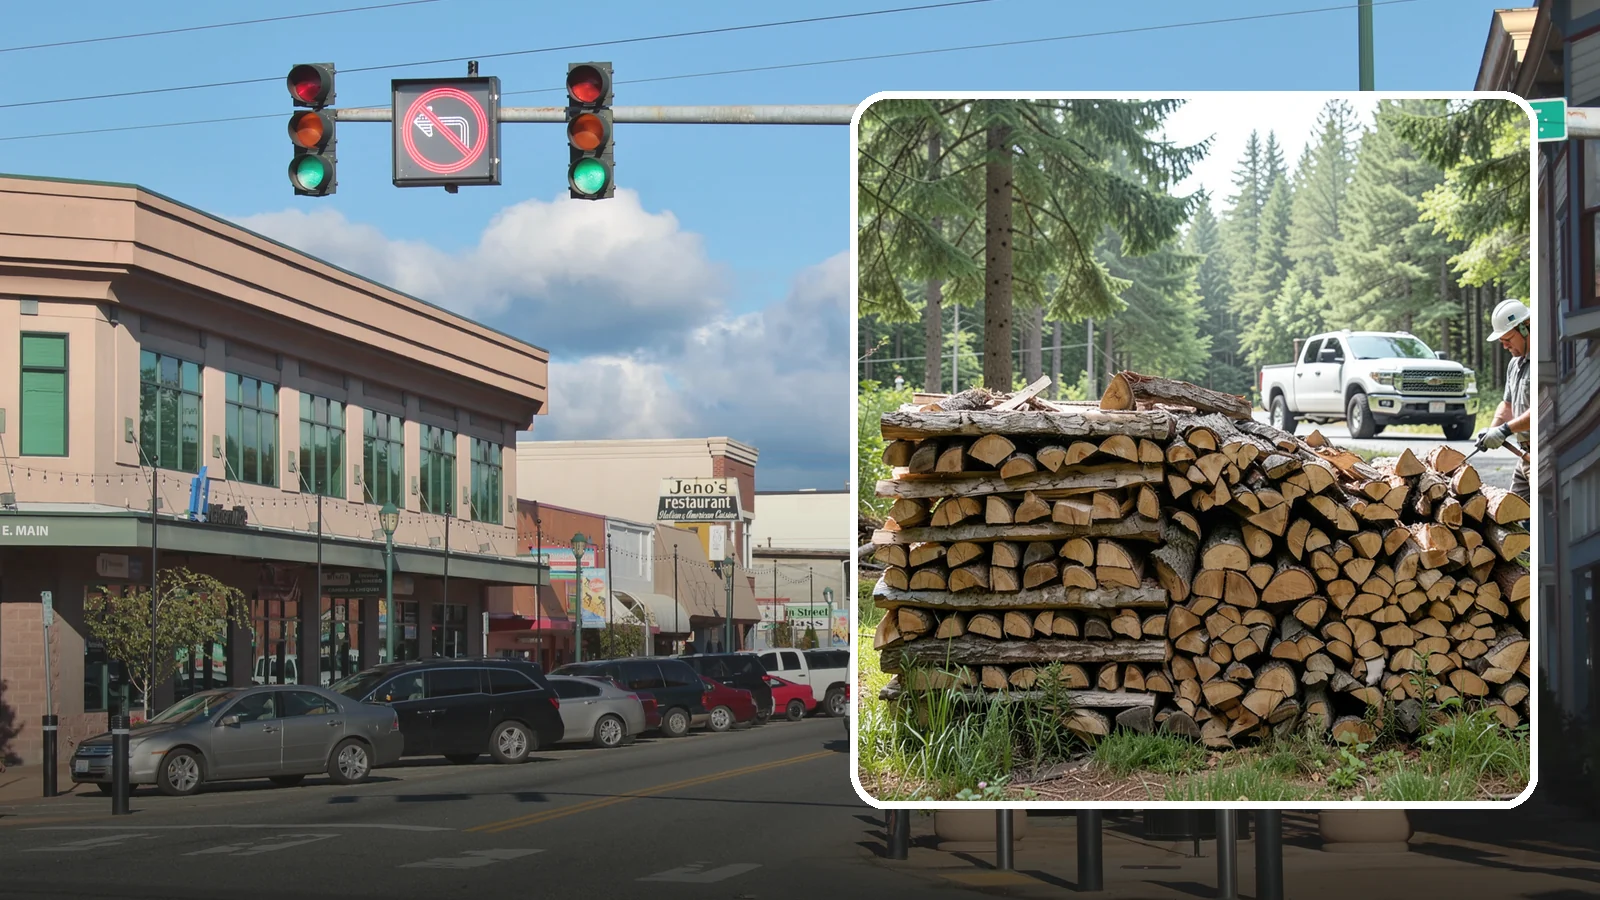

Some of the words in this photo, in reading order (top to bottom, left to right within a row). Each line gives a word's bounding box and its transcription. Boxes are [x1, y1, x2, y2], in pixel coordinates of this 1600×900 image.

[669, 480, 727, 494] Jeno's
[665, 497, 730, 509] restaurant
[686, 510, 714, 519] American
[715, 509, 737, 519] Cuisine
[2, 525, 13, 536] E.
[15, 525, 49, 536] MAIN
[797, 607, 828, 616] Street
